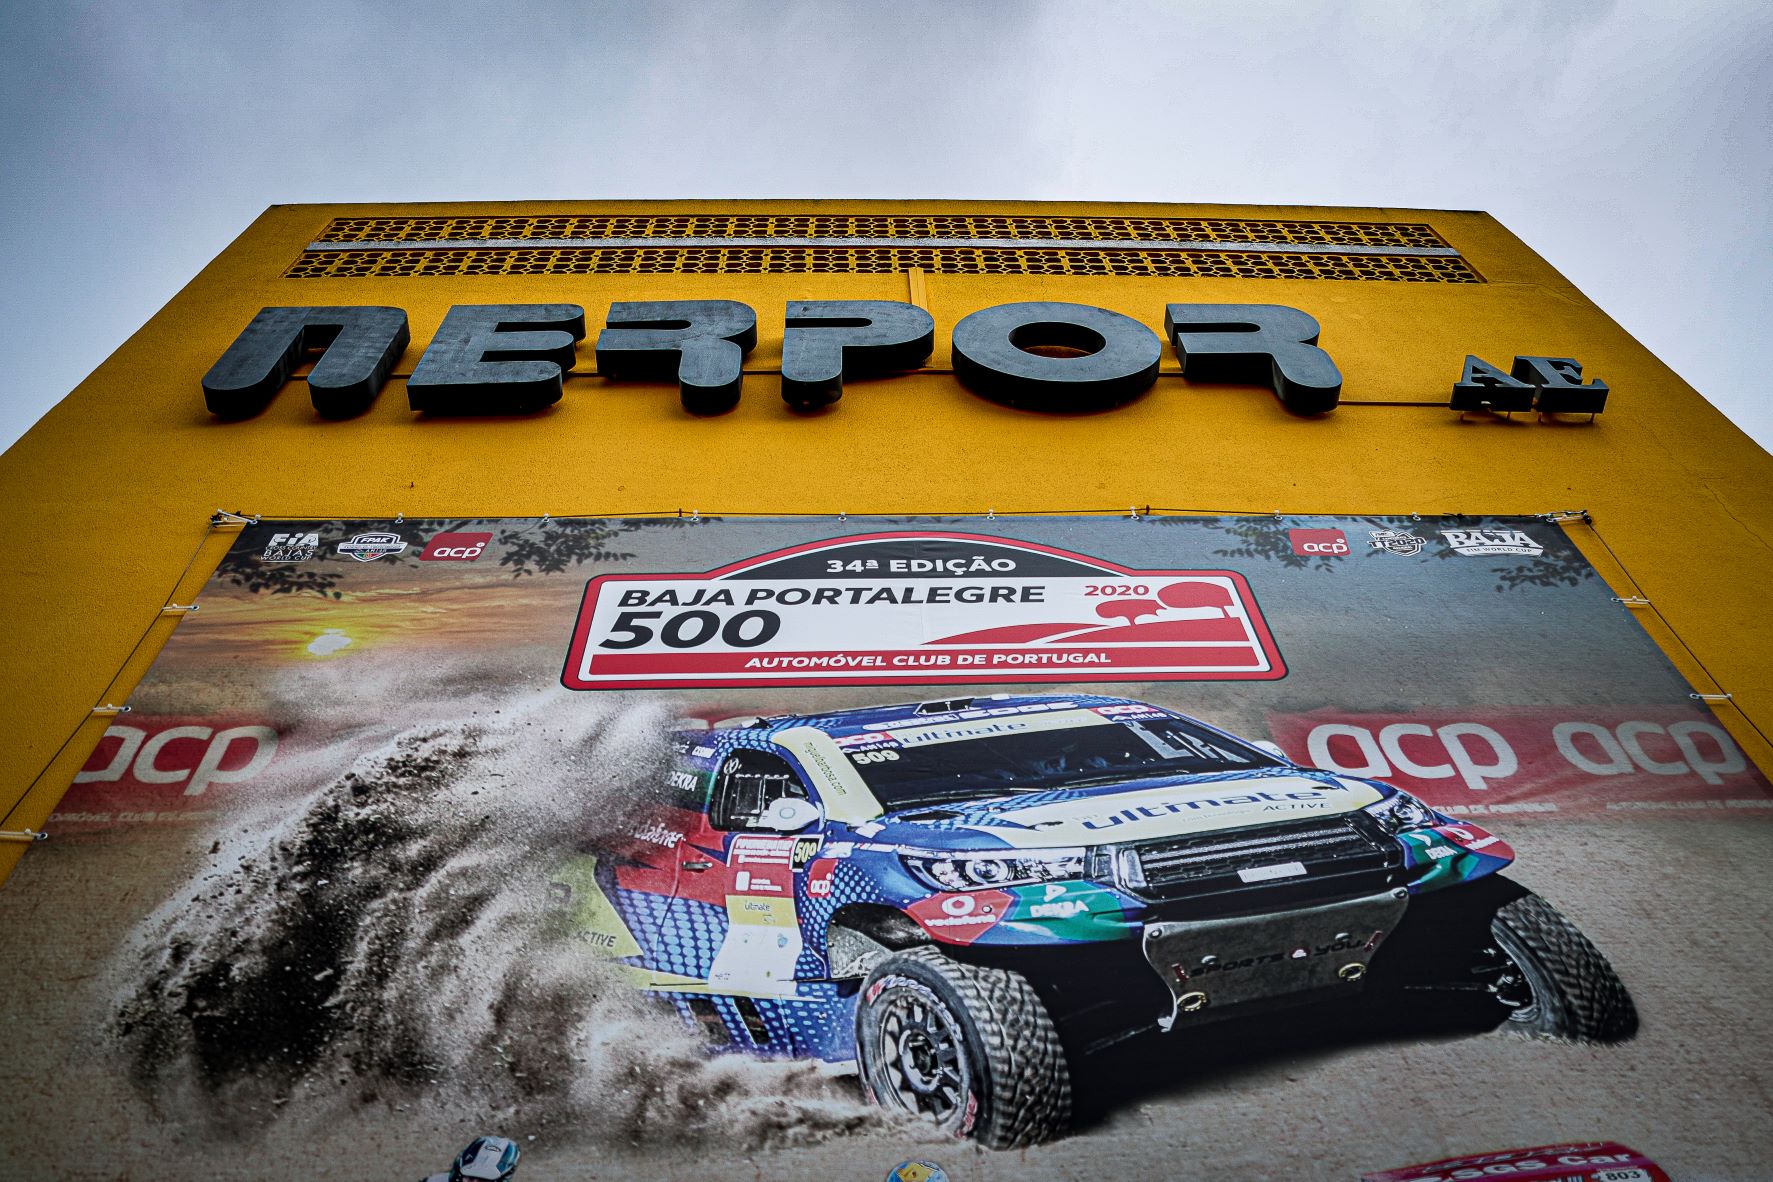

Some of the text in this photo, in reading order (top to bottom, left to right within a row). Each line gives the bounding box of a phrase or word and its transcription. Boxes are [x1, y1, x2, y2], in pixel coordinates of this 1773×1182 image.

[1451, 354, 1609, 413] AE
[1302, 540, 1348, 554] acp
[1440, 529, 1544, 549] BAJA
[433, 544, 483, 558] acp
[889, 555, 1017, 575] EDIÇÃO
[616, 585, 1046, 608] BAJA PORTALEGRE
[1083, 584, 1150, 597] 2020
[597, 609, 782, 650] 500
[744, 652, 1112, 668] AUTOMÓVEL CLUB DE PORTUGAL
[902, 722, 1027, 744] ultimate
[851, 749, 900, 765] 509
[1306, 722, 1519, 790] acp
[1551, 720, 1748, 785] acp
[1081, 791, 1329, 830] ultimate
[1263, 802, 1332, 811] ACTIVE
[1556, 1150, 1632, 1165] Car
[1605, 1169, 1641, 1182] 803
